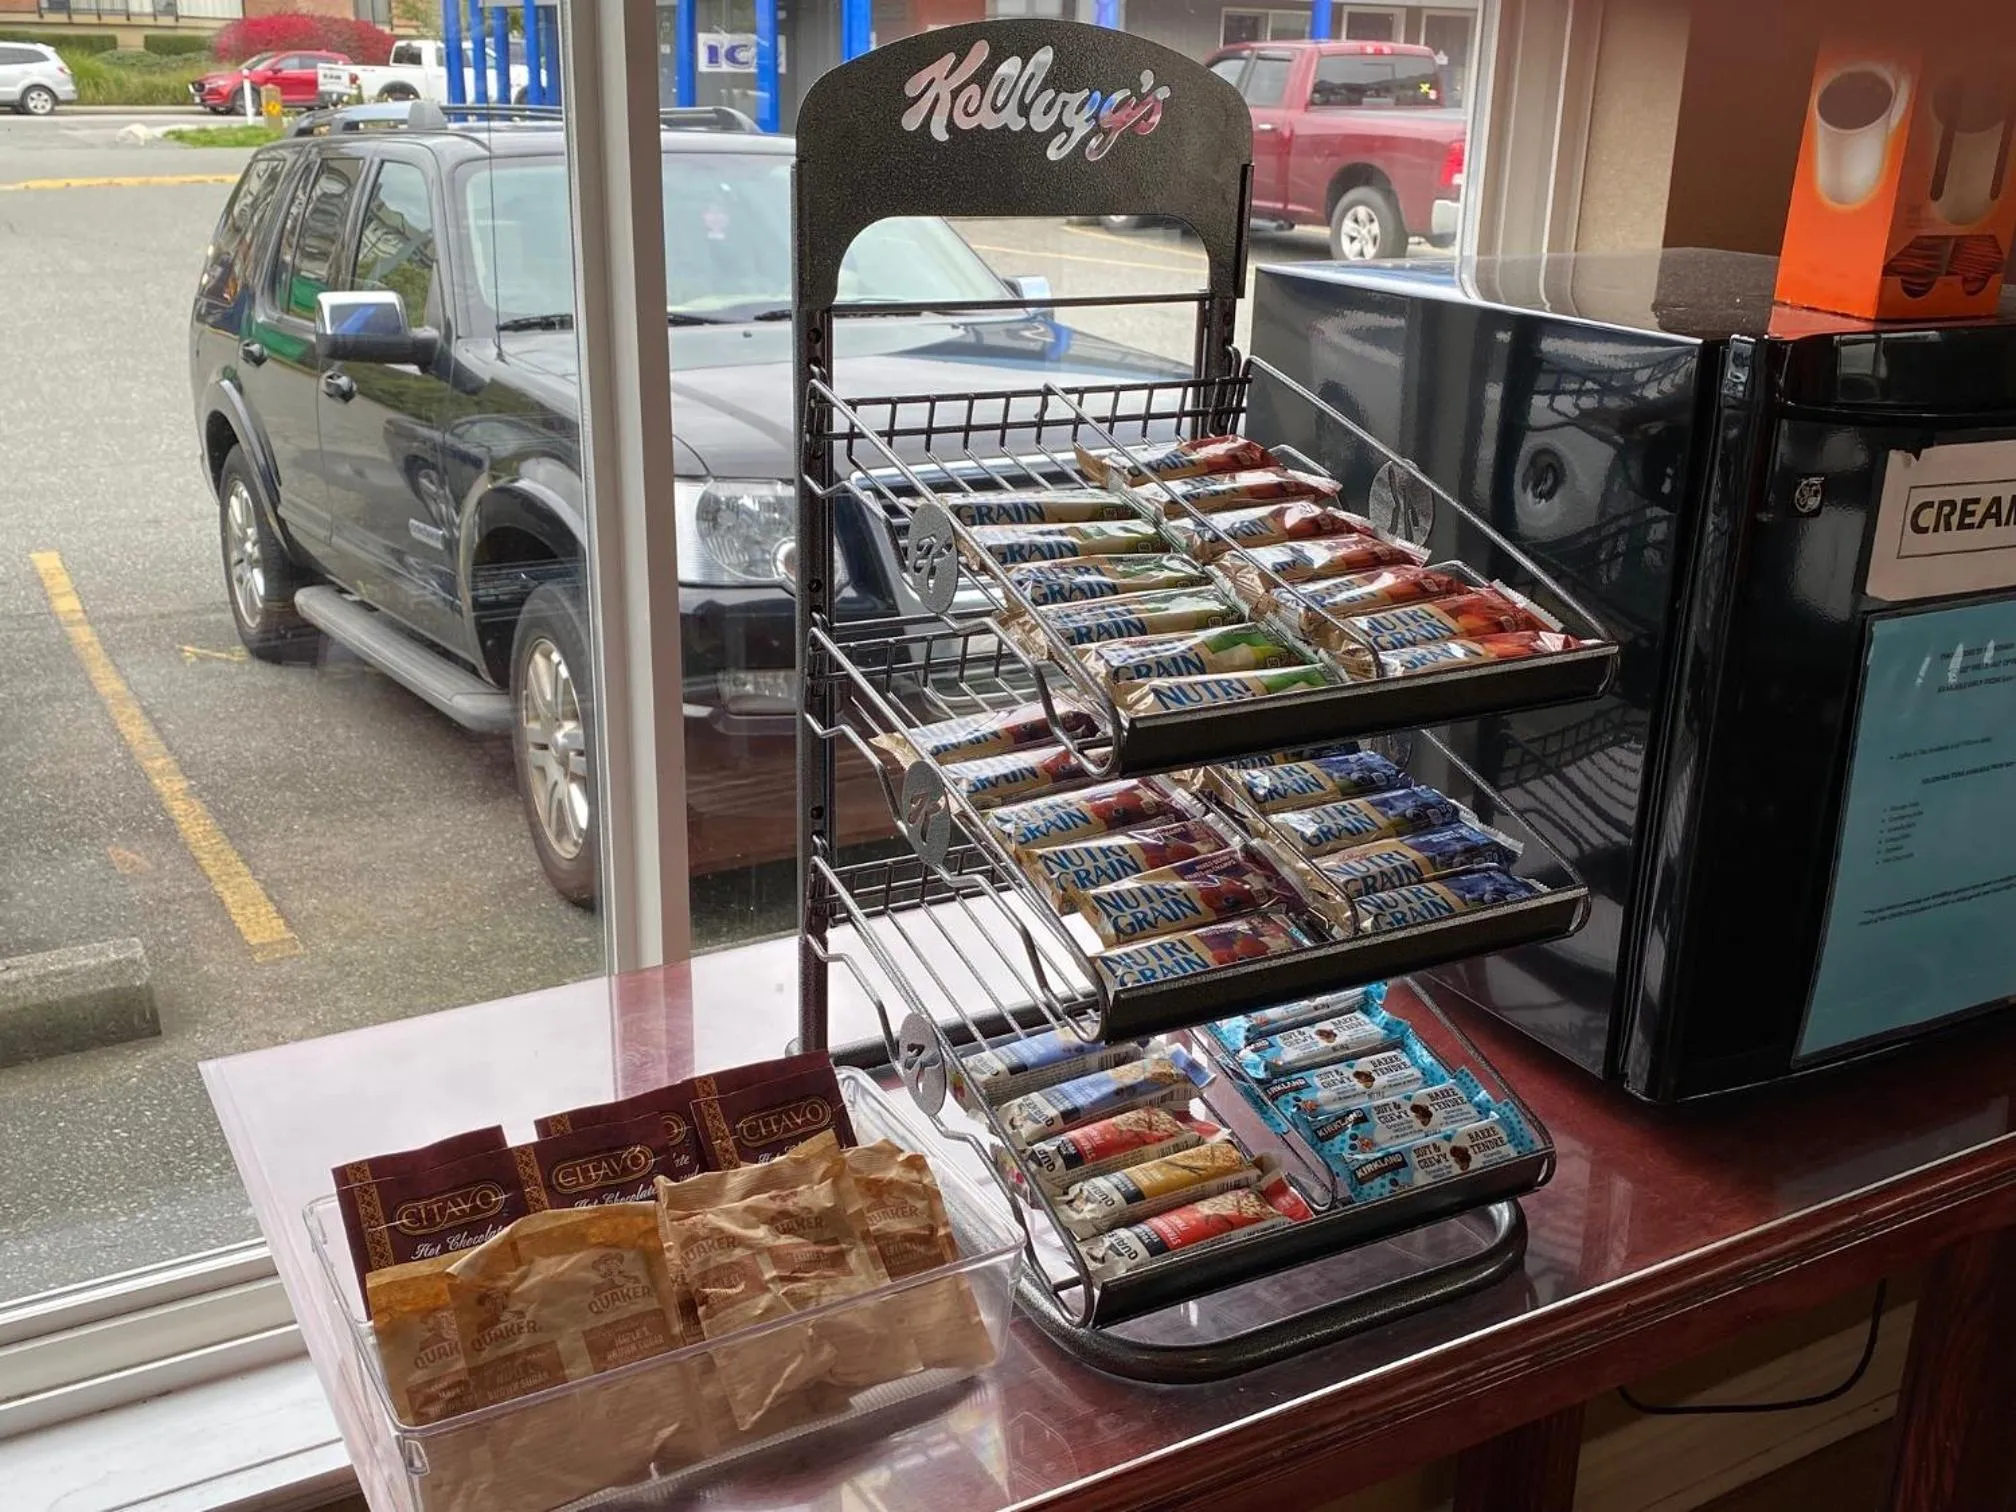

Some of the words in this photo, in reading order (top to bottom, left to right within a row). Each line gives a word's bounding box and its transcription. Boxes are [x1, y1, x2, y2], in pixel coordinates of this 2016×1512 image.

[903, 40, 1170, 160] Kellogg's
[955, 502, 1046, 527] GRAIN
[1371, 617, 1456, 652] GRAIN
[1112, 651, 1207, 684] GRAIN
[1150, 678, 1252, 710] NUTRI
[1300, 814, 1381, 848] GRAIN
[1038, 845, 1129, 876] NUTRI
[1056, 855, 1143, 890] GRAIN
[1322, 849, 1410, 875] NUTRI
[1343, 860, 1425, 898] GRAIN
[1091, 885, 1184, 919] NUTRI
[1111, 893, 1203, 937] GRAIN
[1356, 884, 1440, 915] NUTRI
[1372, 896, 1456, 931] GRAIN
[1099, 938, 1195, 979] NUTRI
[1118, 953, 1212, 988] GRAIN
[1369, 1054, 1402, 1068] BARRE
[1372, 1062, 1411, 1077] TENDRE
[1321, 1076, 1353, 1089] CHEWY
[1428, 1088, 1459, 1102] BARRE
[1374, 1102, 1392, 1115] SOFT
[1392, 1101, 1401, 1110] &
[1377, 1109, 1411, 1125] CHEWY
[1430, 1096, 1468, 1112] TENDRE
[742, 1102, 823, 1141] CITAVO
[1316, 1109, 1364, 1138] KIRKLAND
[1467, 1126, 1499, 1143] BARRE
[1413, 1146, 1433, 1159] SOFT
[1433, 1142, 1442, 1153] &
[1417, 1152, 1450, 1170] CHEWY
[1469, 1136, 1508, 1155] TENDRE
[557, 1149, 646, 1187] CITAVO
[1355, 1154, 1403, 1179] KIRKLAND
[401, 1189, 497, 1228] CITAVO
[410, 1242, 441, 1260] Hot
[446, 1223, 508, 1252] Chocolat
[588, 1285, 653, 1315] QUAKER
[470, 1319, 540, 1353] QUAKER
